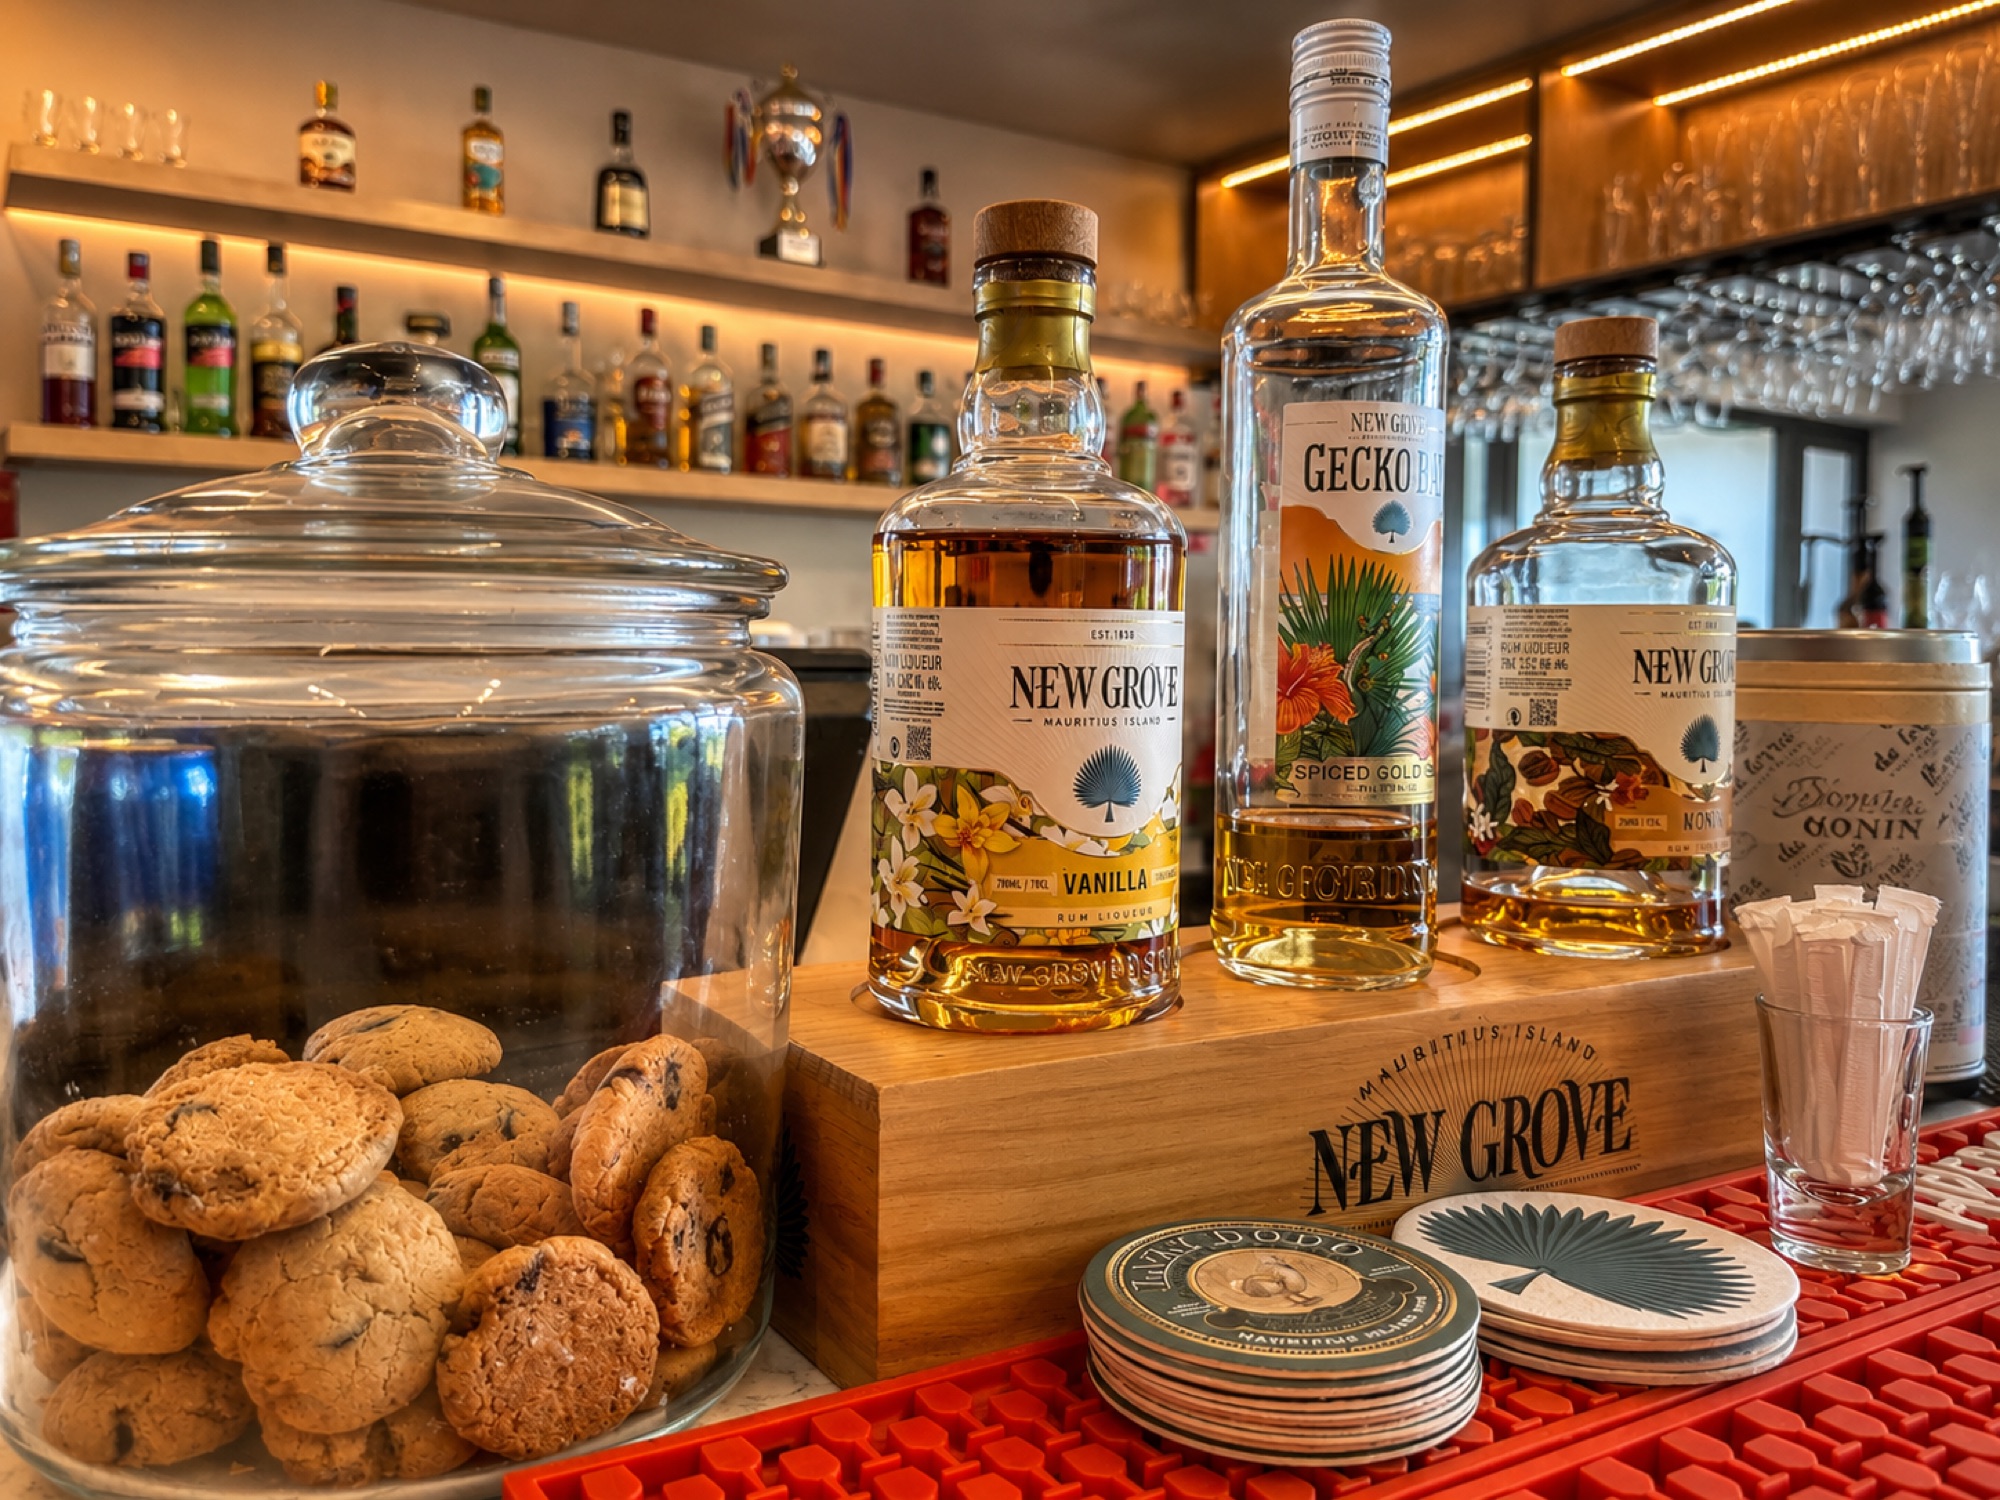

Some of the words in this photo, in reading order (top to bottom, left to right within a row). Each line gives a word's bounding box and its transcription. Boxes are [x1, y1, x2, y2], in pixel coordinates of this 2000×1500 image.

[1350, 412, 1388, 432] NEW
[1304, 443, 1411, 493] GECKO
[1633, 646, 1697, 684] NEW
[1009, 663, 1098, 709] NEW
[1101, 664, 1178, 710] GROVE
[1043, 717, 1118, 727] MAURITIUS
[1123, 716, 1161, 727] ISLAND
[1294, 764, 1371, 781] SPICED
[1063, 868, 1148, 895] VANILLA
[1057, 913, 1089, 924] RUM
[1514, 1023, 1596, 1061] ISLAND
[1306, 1108, 1447, 1217] NEW
[1459, 1076, 1631, 1183] GROVE
